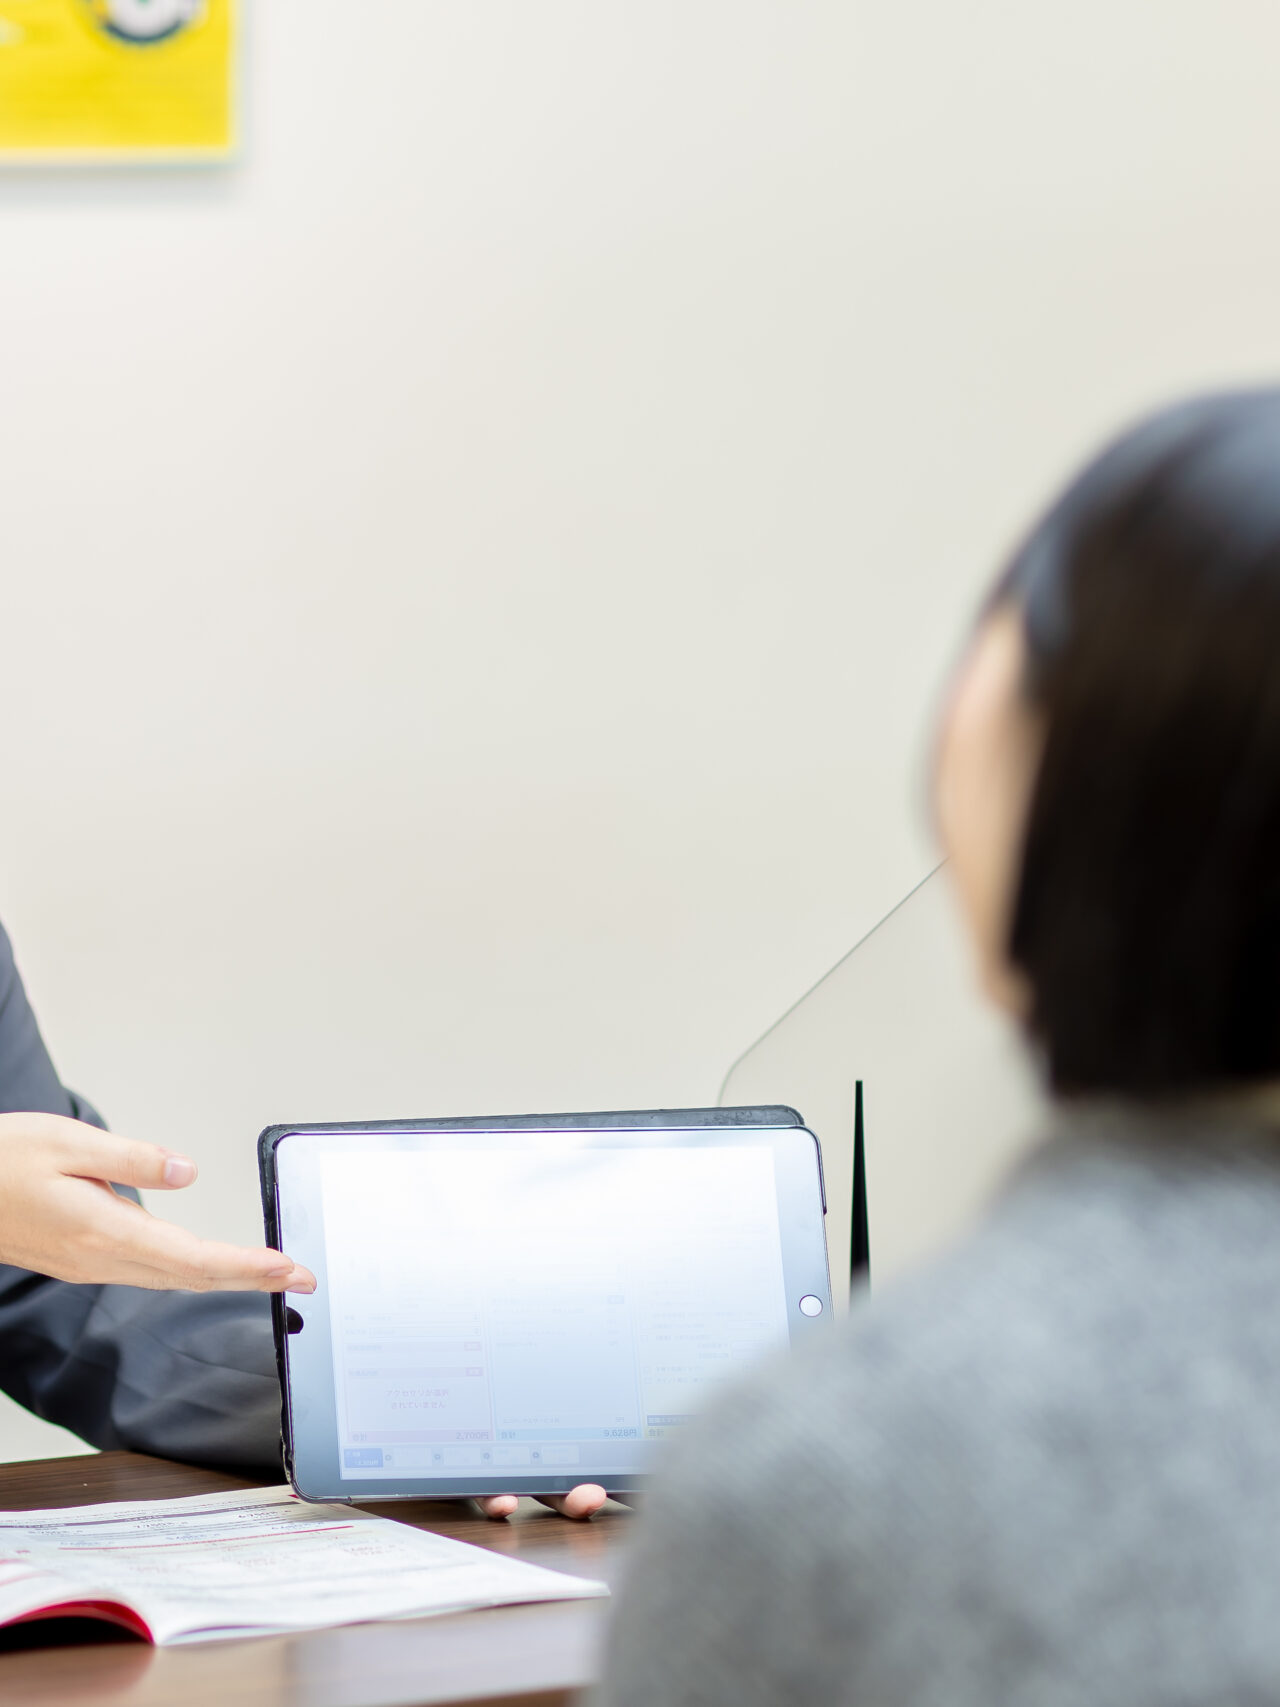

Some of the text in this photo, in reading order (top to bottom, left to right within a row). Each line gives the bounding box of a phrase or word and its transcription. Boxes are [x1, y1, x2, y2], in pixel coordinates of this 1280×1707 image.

[391, 1401, 446, 1409] されていません
